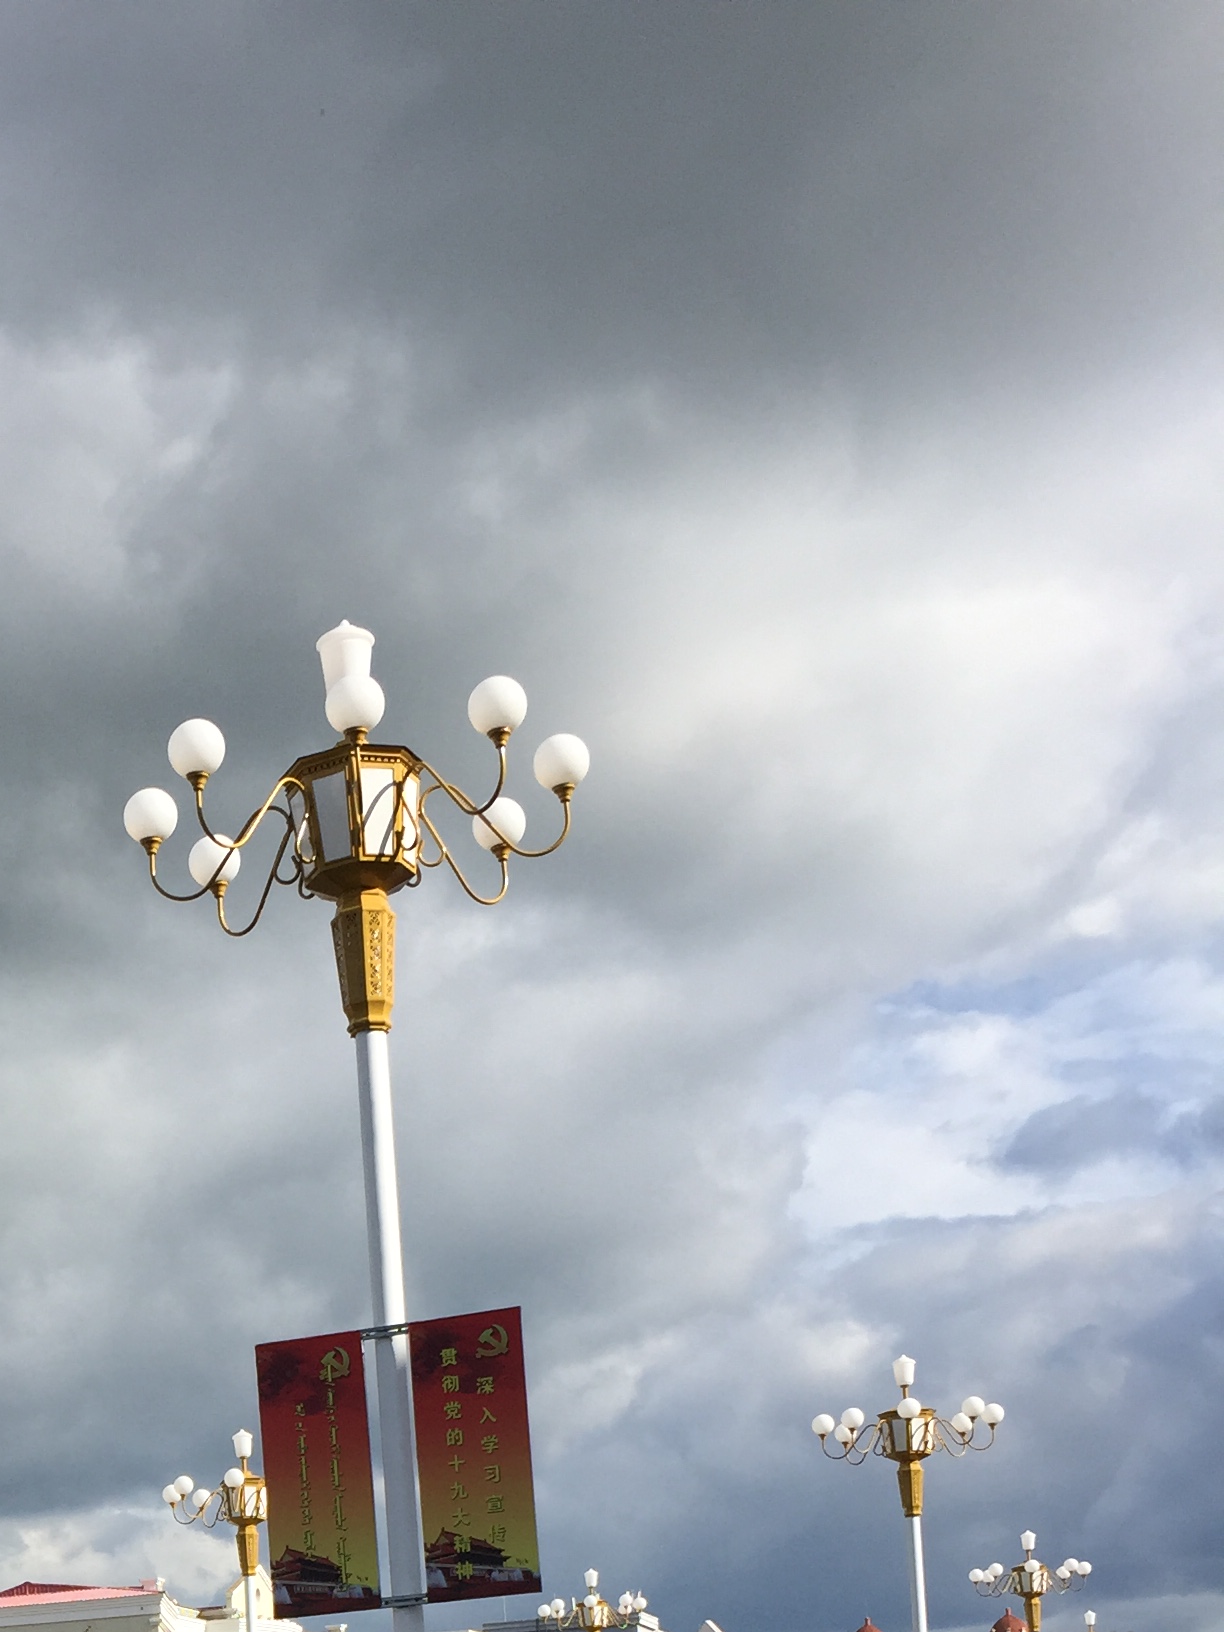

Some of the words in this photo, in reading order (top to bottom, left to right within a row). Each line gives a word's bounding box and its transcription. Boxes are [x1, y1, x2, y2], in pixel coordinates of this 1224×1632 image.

[440, 1347, 474, 1581] 贯彻党的十九大精神
[476, 1376, 507, 1544] 深入学习宣传
